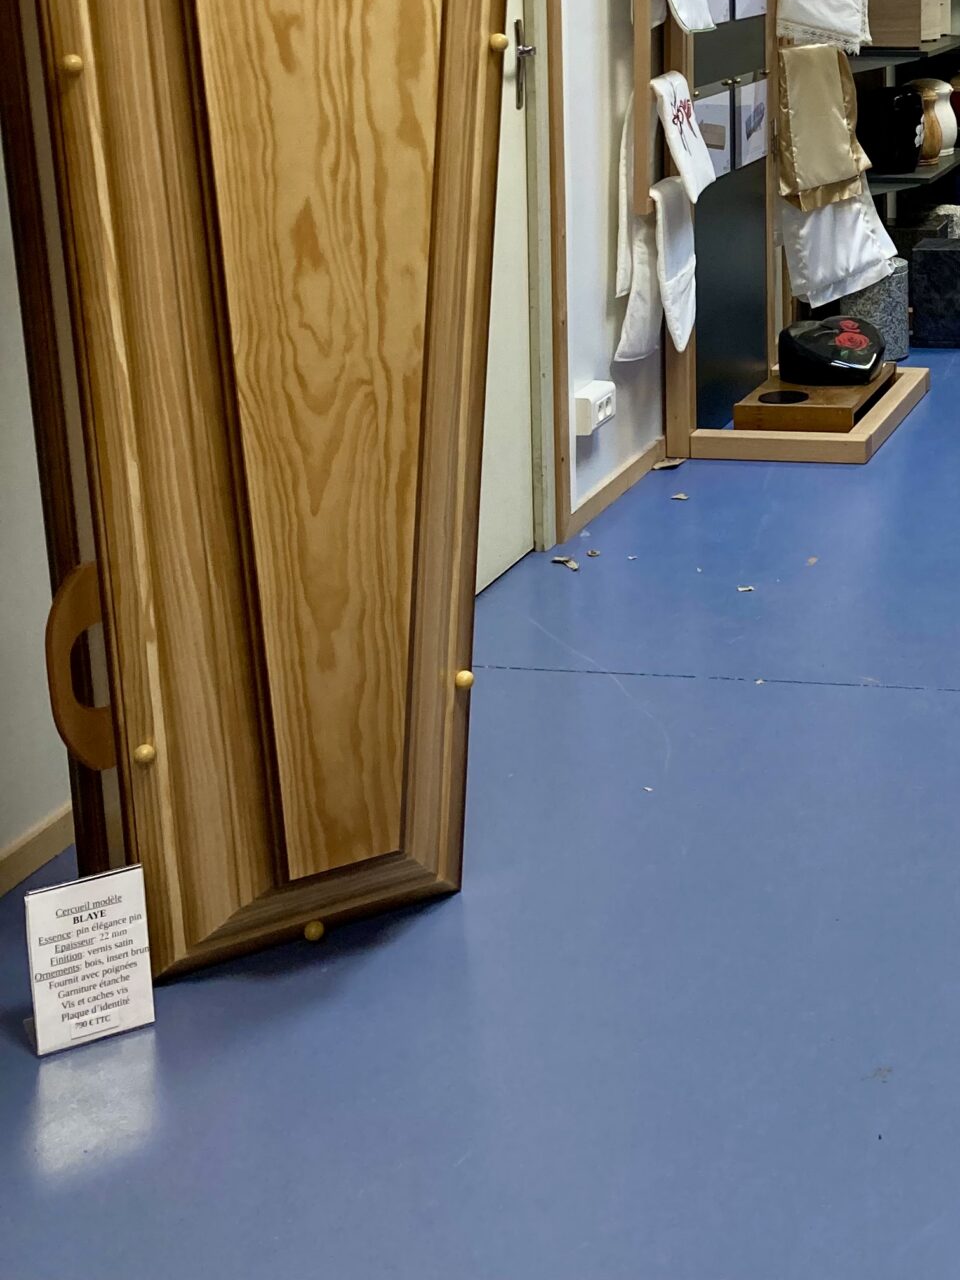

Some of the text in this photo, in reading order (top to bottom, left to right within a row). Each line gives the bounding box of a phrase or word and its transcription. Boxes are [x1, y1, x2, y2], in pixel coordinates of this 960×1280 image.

[55, 894, 122, 918] Cercueil modèle
[73, 909, 107, 925] BLAYE
[76, 927, 90, 937] pin
[91, 916, 127, 930] élégance
[129, 913, 142, 924] pin
[100, 931, 109, 941] 22
[111, 928, 128, 938] mm
[84, 958, 104, 969] bois,
[106, 951, 129, 962] insert
[131, 946, 150, 956] brun
[87, 945, 113, 956] vernis
[114, 938, 134, 948] satin
[48, 961, 138, 990] Fournit avec poignées
[57, 974, 131, 999] Garniture étanche
[61, 986, 129, 1010] Vis et caches vis
[61, 1008, 90, 1022] Plaque
[95, 1015, 112, 1024] TTC
